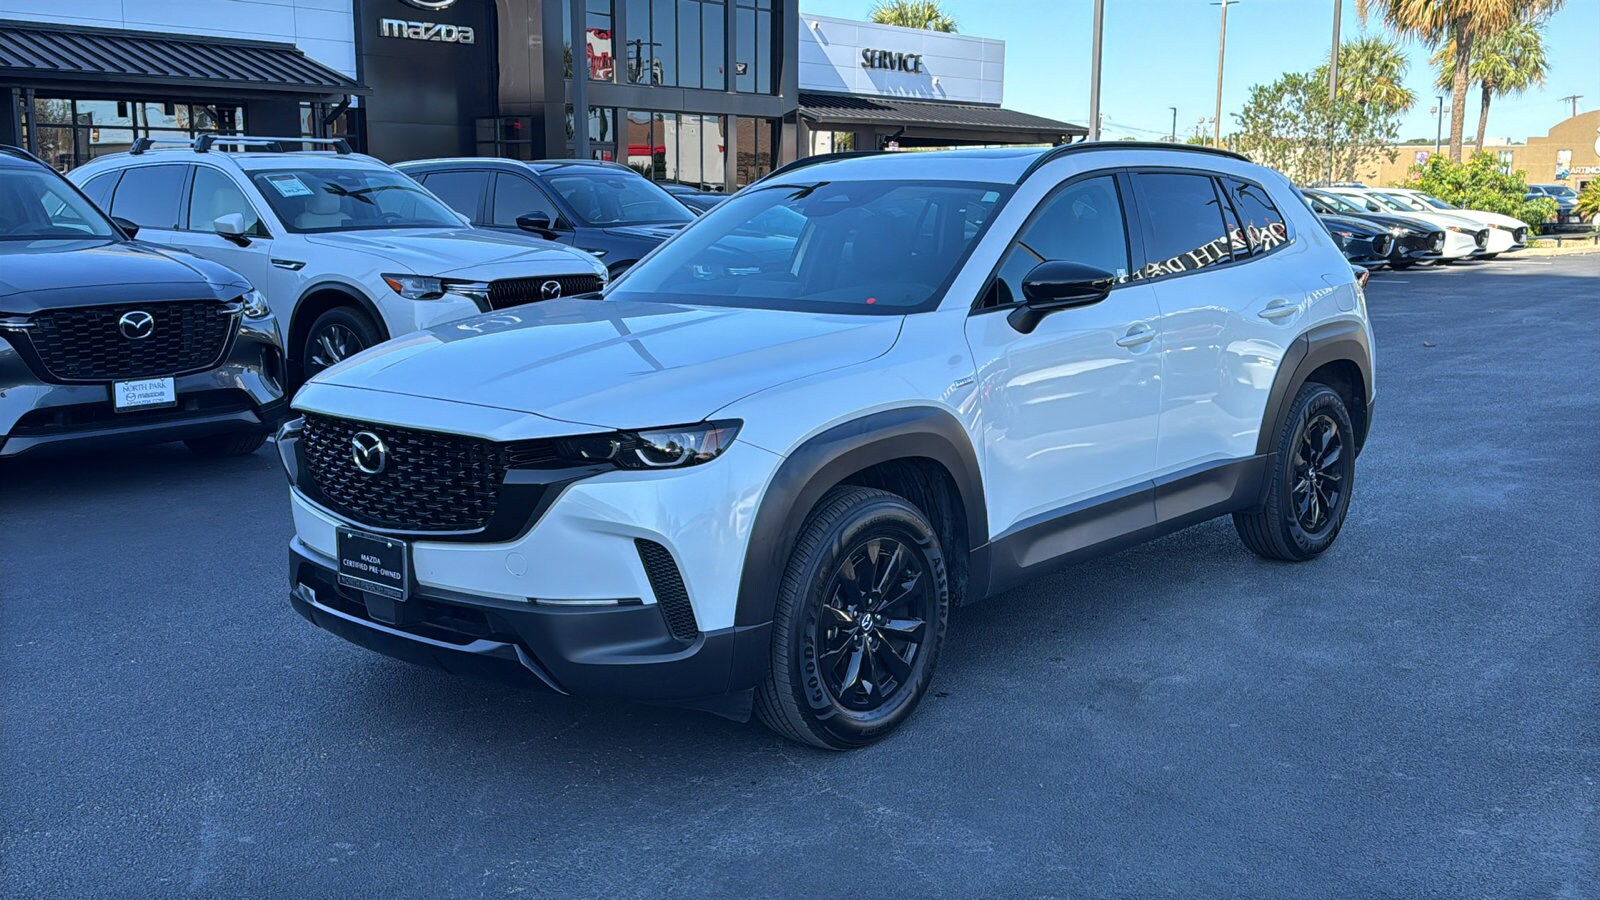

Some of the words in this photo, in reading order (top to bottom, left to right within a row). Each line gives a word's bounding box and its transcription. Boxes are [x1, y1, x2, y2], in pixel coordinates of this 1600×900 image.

[379, 18, 475, 44] mazda
[861, 48, 923, 73] SERVICE
[149, 382, 167, 390] PARK
[343, 559, 368, 571] CERTIFIED
[369, 566, 401, 580] PRE-OWNED
[361, 554, 381, 565] MAZDA
